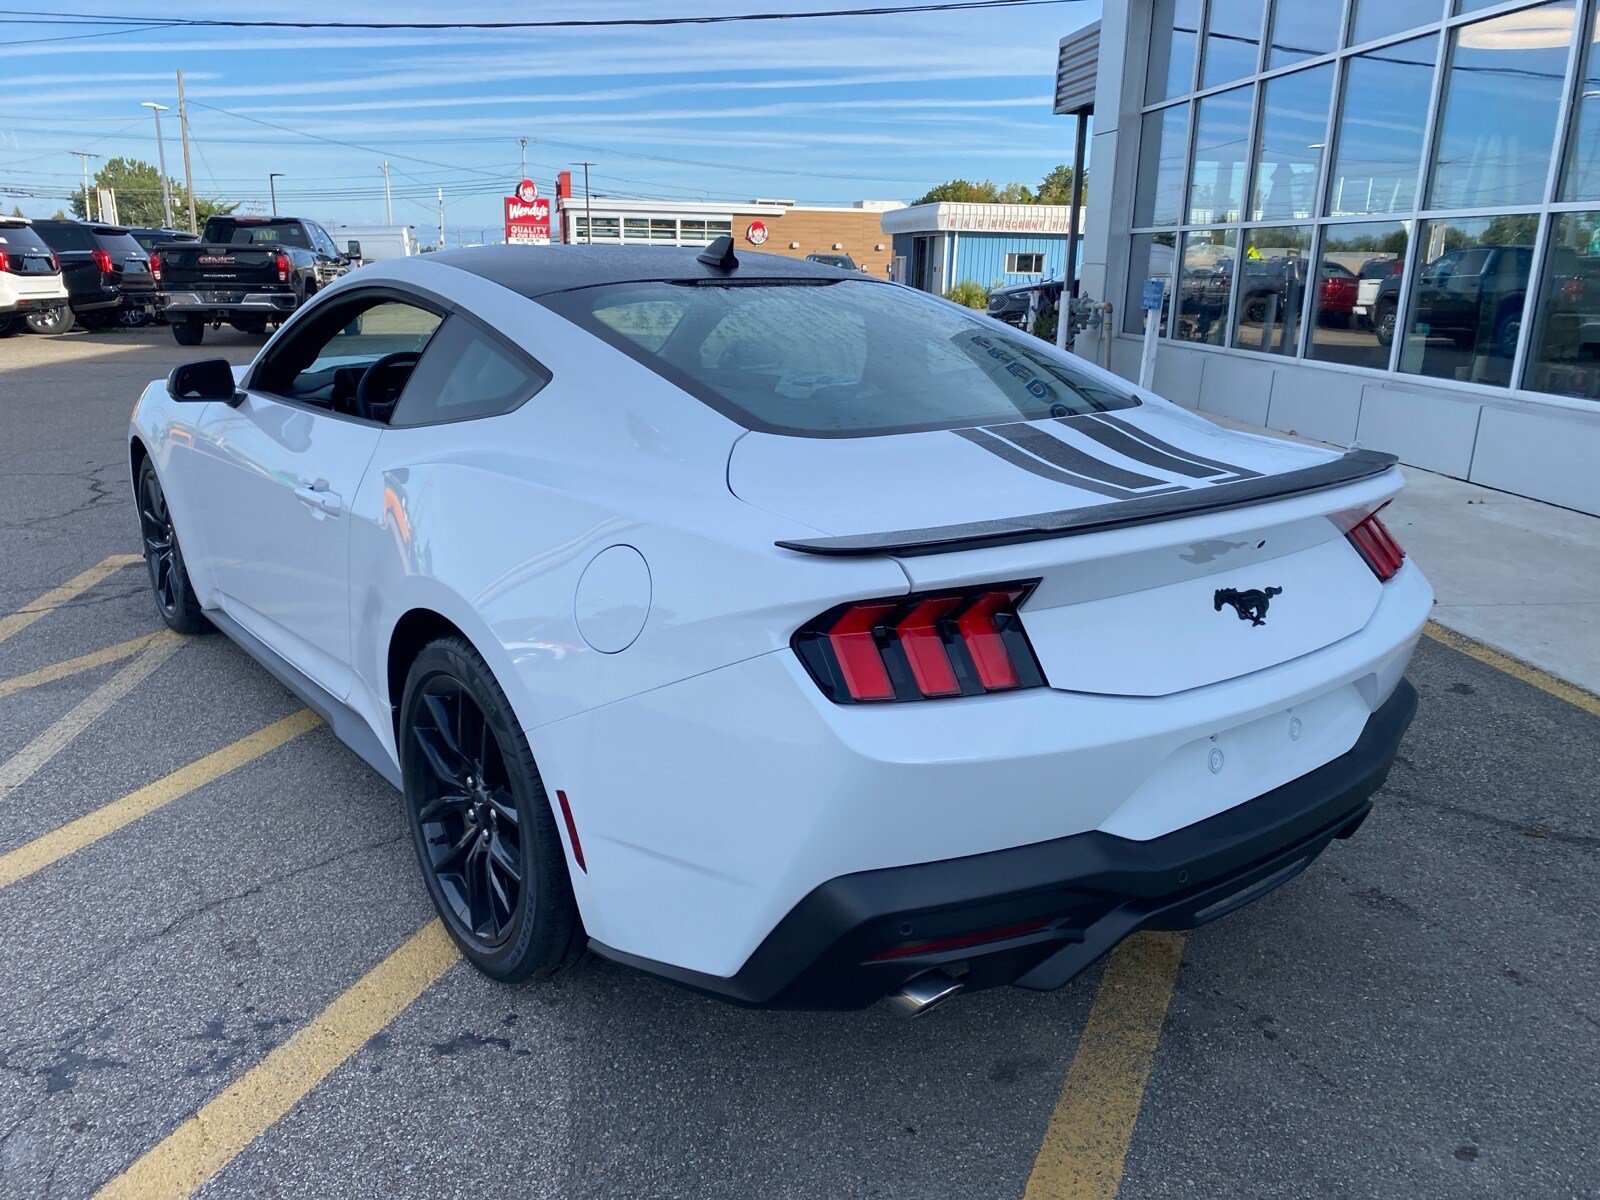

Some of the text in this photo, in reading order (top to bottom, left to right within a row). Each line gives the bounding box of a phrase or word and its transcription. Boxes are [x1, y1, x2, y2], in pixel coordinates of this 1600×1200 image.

[508, 202, 548, 220] Wendy's
[510, 225, 547, 233] QUALITY
[990, 219, 1044, 230] DISCOUNT
